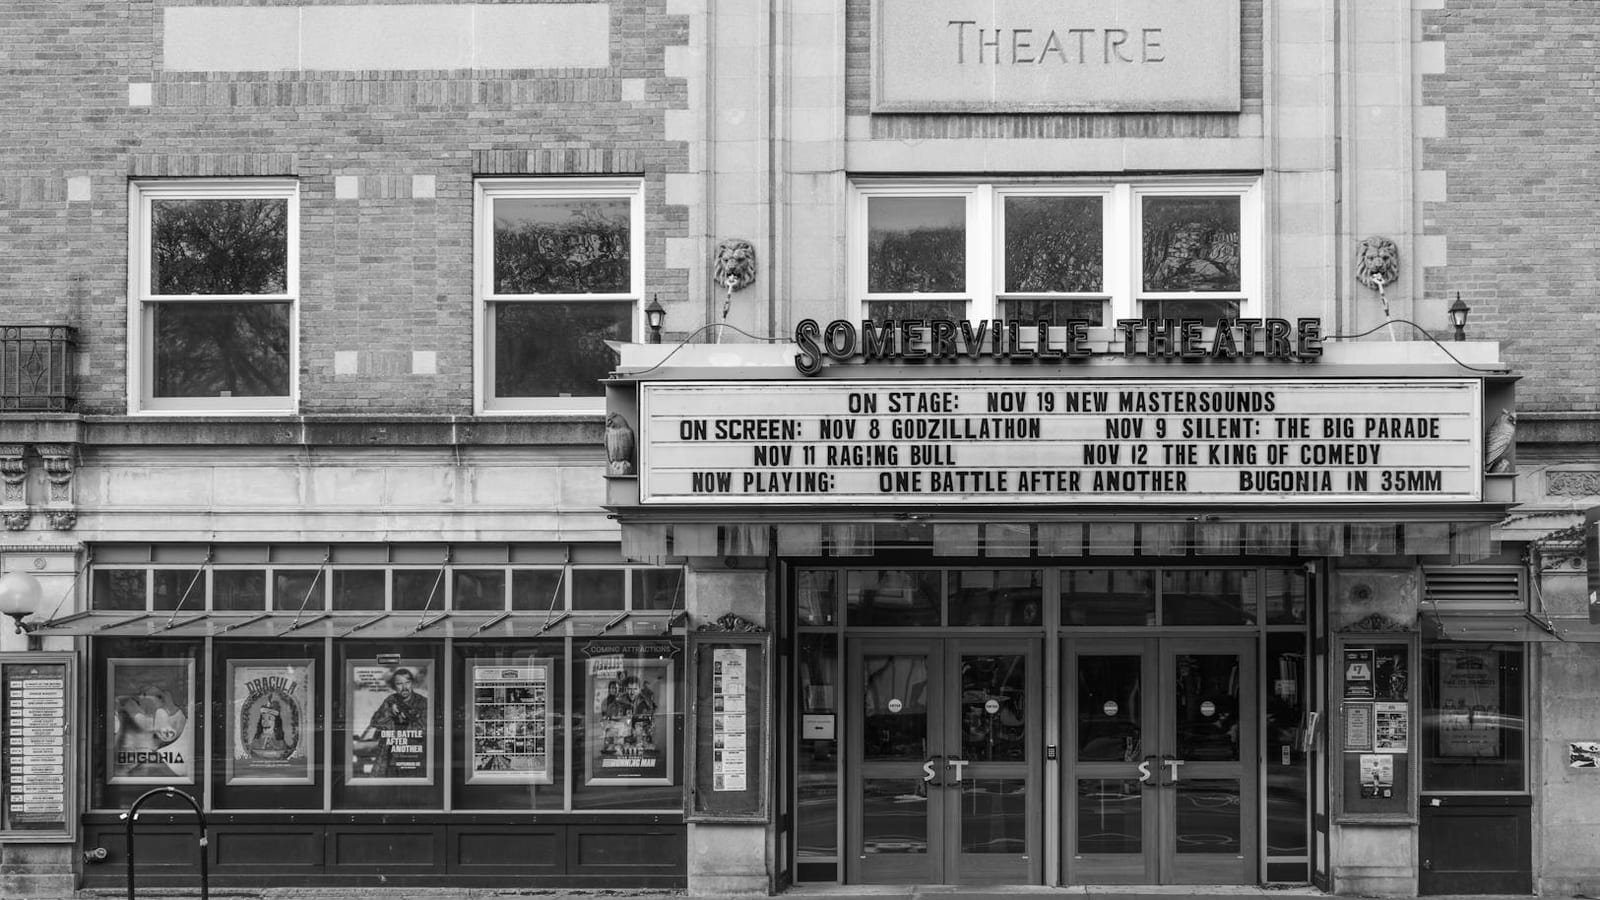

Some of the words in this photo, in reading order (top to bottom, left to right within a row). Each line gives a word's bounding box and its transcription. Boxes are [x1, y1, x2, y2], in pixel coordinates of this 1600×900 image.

[948, 20, 1165, 64] THEATRE
[795, 319, 1092, 376] SOMERVILLE
[1117, 318, 1325, 360] THEATRE
[849, 392, 877, 413] ON
[889, 392, 959, 413] STAGE:
[988, 392, 1026, 412] NOV
[1037, 392, 1055, 412] 19
[1067, 392, 1108, 412] NEW
[1119, 391, 1276, 412] MASTERSOUNDS
[680, 420, 707, 440] ON
[716, 420, 802, 440] SCREEN:
[820, 419, 856, 440] NOV
[869, 419, 881, 439] 8
[893, 418, 1041, 440] GODZILLATHON
[1106, 418, 1143, 439] NOV
[1156, 418, 1167, 439] 9
[1183, 418, 1260, 439] SILENT:
[1275, 418, 1310, 438] THE
[1323, 418, 1354, 439] BIG
[1366, 417, 1440, 438] PARADE
[754, 445, 792, 466] NOV
[803, 445, 816, 466] 11
[911, 445, 956, 466] BULL
[1084, 444, 1119, 465] NOV
[1132, 444, 1148, 465] 12
[1162, 444, 1197, 465] THE
[1209, 444, 1257, 464] KING
[1268, 444, 1289, 465] OF
[1301, 444, 1380, 465] COMEDY
[693, 472, 731, 493] NOW
[744, 472, 835, 493] PLAYING:
[880, 472, 921, 493] ONE
[931, 471, 1007, 493] BATTLE
[1018, 471, 1080, 492] AFTER
[1093, 471, 1187, 493] ANOTHER
[1240, 471, 1332, 492] BUGONIA
[1347, 471, 1368, 492] IN
[1382, 471, 1442, 491] 35MM
[591, 645, 620, 653] COMING
[622, 645, 671, 653] ATTRACTIONS
[244, 676, 298, 696] DRACULA
[381, 730, 395, 738] ONE
[397, 730, 423, 738] BATTLE
[391, 745, 423, 753] ANOTHER
[923, 761, 936, 782] S
[949, 760, 969, 782] T
[1138, 761, 1151, 782] S
[1164, 760, 1184, 781] T
